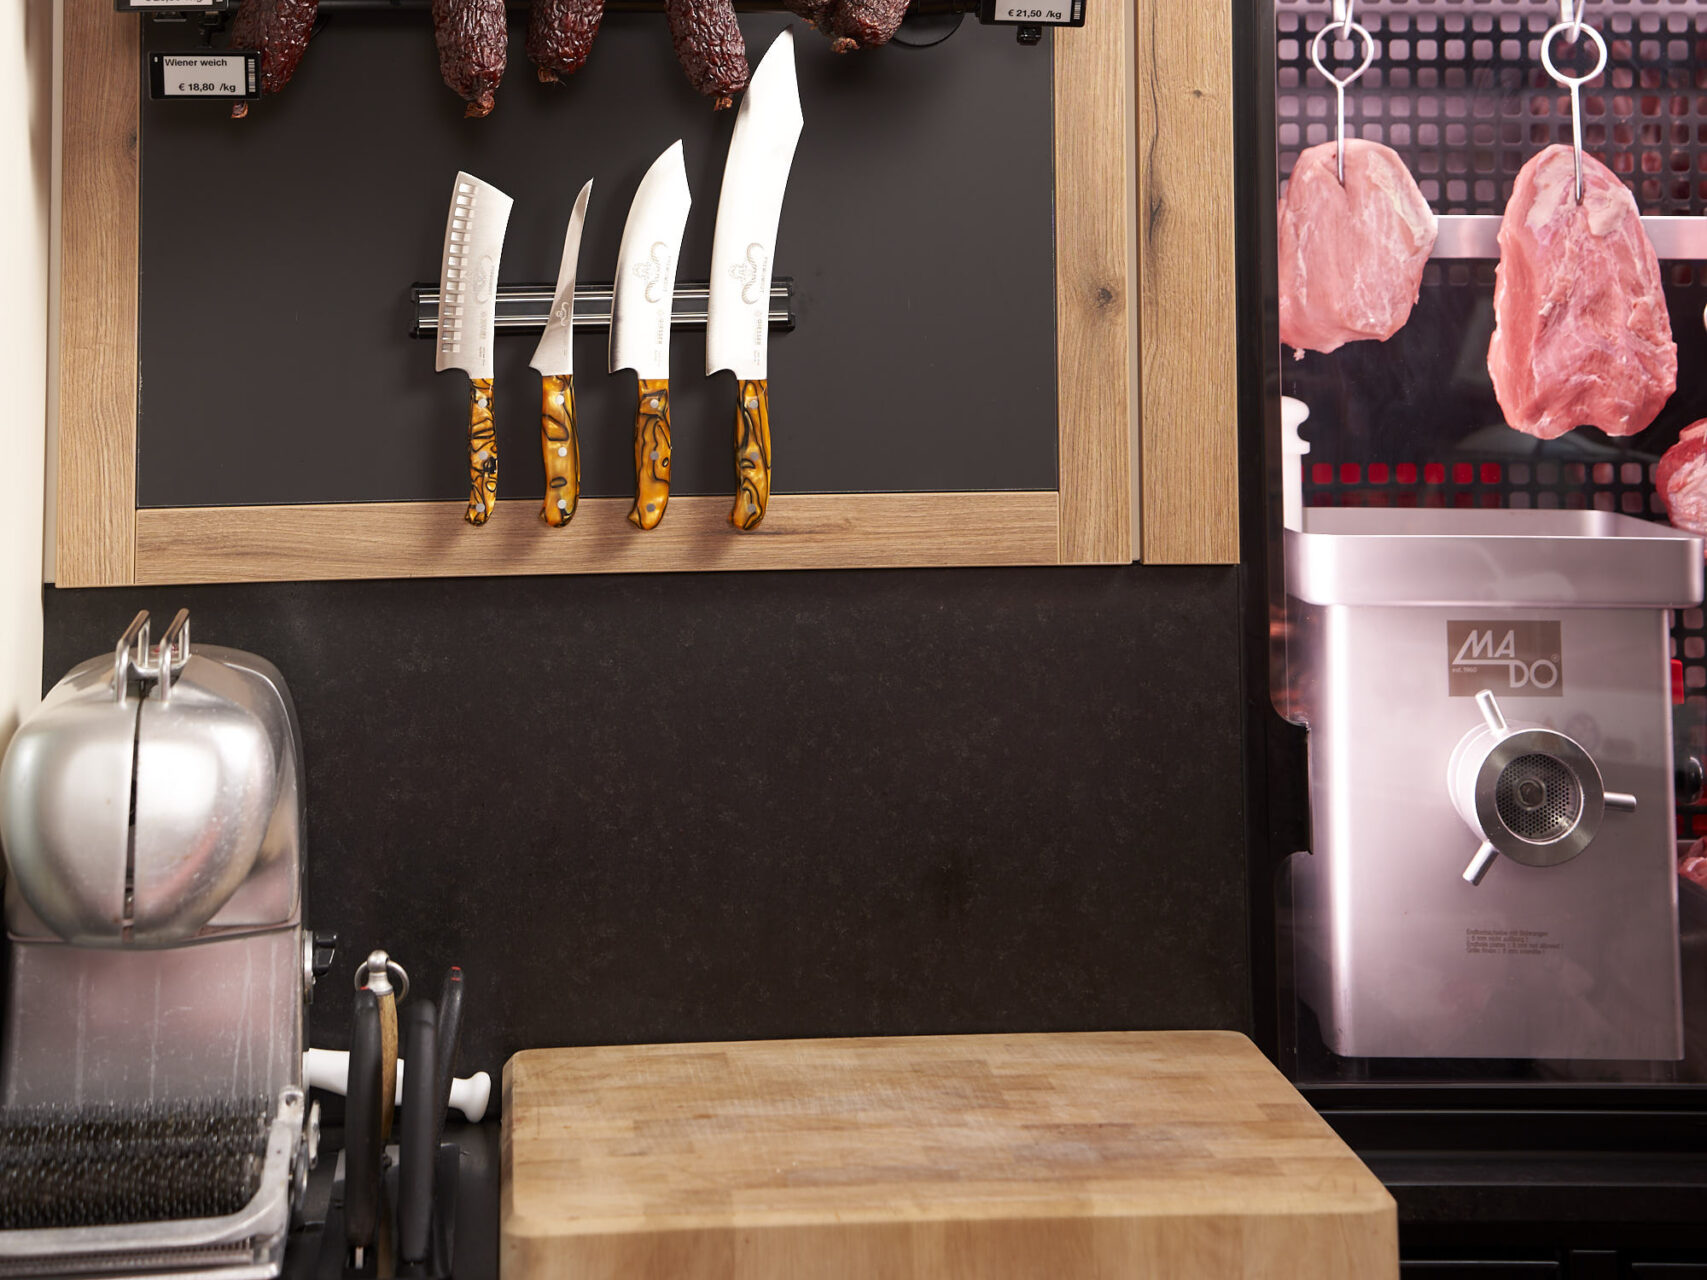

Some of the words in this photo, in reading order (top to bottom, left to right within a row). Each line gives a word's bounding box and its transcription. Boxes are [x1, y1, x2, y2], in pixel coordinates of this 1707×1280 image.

[1008, 9, 1015, 17] €
[1016, 9, 1042, 18] 21,50
[1046, 10, 1062, 19] /kg
[164, 58, 198, 67] Wiener
[200, 58, 228, 67] weich
[178, 83, 185, 91] €
[188, 83, 215, 92] 18,80
[219, 83, 236, 93] /kg
